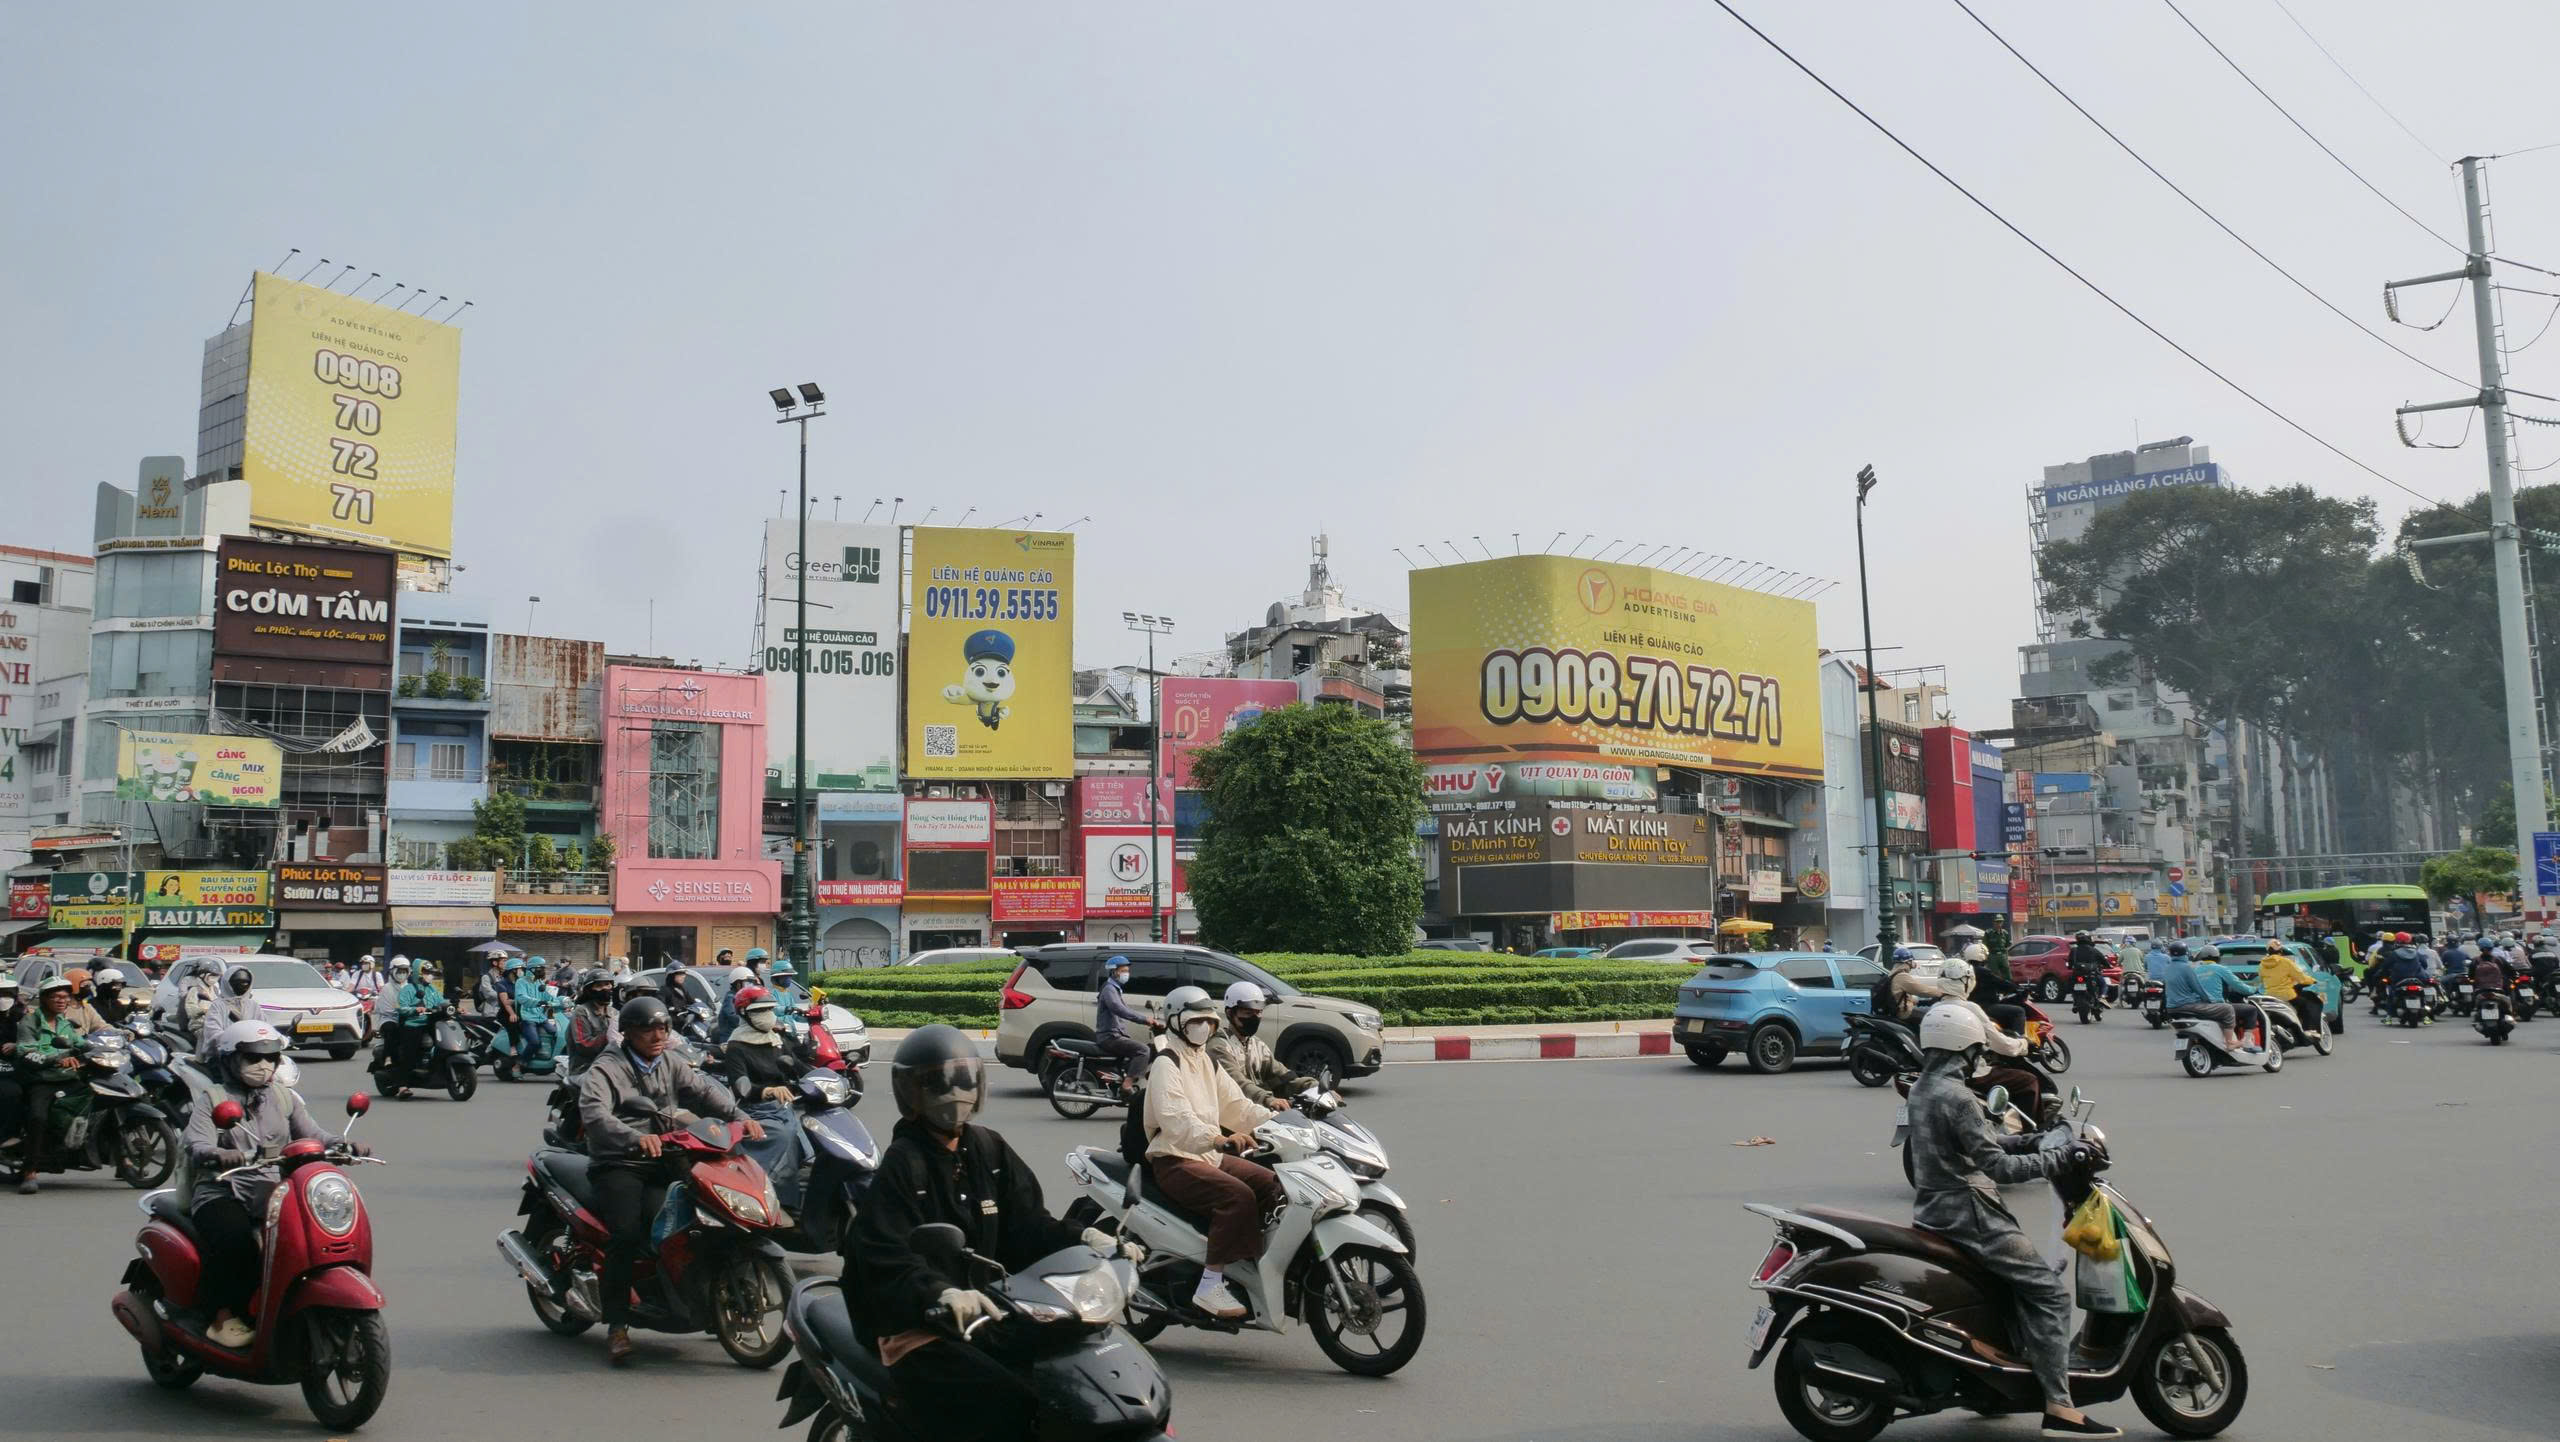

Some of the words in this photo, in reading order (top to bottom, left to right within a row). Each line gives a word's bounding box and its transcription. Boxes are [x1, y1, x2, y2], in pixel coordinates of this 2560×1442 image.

[312, 331, 332, 343] LIÊN
[330, 317, 402, 341] ADVERTISING
[314, 349, 401, 400] 0908
[333, 393, 381, 436] 70
[330, 437, 379, 480] 72
[2057, 485, 2099, 502] NGÂN
[2102, 479, 2146, 497] HÀNG
[2149, 477, 2160, 489] Á
[2162, 469, 2206, 486] CHÂU
[330, 483, 374, 525] 71
[227, 557, 262, 573] Phúc
[266, 561, 290, 578] Lộc
[293, 563, 318, 581] Thọ
[932, 566, 960, 581] LIÊN
[964, 567, 980, 585] HỆ
[984, 568, 1025, 583] QUẢNG
[1029, 569, 1053, 583] CÁO
[226, 588, 309, 617] CƠM
[316, 589, 389, 623] TẤM
[925, 586, 1059, 621] 0911.39.5555
[1624, 602, 1697, 623] ADVERTISING
[809, 631, 822, 643] HỆ
[823, 631, 854, 643] QUẢNG
[855, 633, 874, 644] CÁO
[1603, 630, 1627, 644] LIÊN
[1630, 633, 1644, 648] HỆ
[1647, 636, 1682, 652] QUẢNG
[1683, 642, 1704, 656] CÁO
[1480, 647, 1783, 746] 0908.70.72.71
[622, 703, 658, 714] GELATO
[711, 710, 730, 719] EGG
[730, 711, 753, 720] TART
[216, 748, 246, 760] CÀNG
[1610, 747, 1704, 765] WWW.HOANGGIAADV.COM
[210, 768, 240, 782] CÀNG
[241, 763, 265, 773] MIX
[1520, 766, 1542, 780] VỊT
[1546, 767, 1580, 779] QUAY
[1602, 766, 1632, 782] GIÒN
[1422, 769, 1478, 793] NHƯ
[1484, 765, 1503, 790] Ý
[232, 785, 264, 796] NGON
[1447, 813, 1489, 838] MẮT
[1494, 813, 1541, 835] KÍNH
[1586, 811, 1624, 834] MẮT
[1629, 815, 1668, 837] KÍNH
[1452, 840, 1470, 851] Dr.
[1472, 838, 1507, 850] Minh
[1511, 836, 1536, 850] Tây
[1608, 837, 1627, 851] Dr.
[1628, 838, 1660, 852] Minh
[1663, 838, 1686, 854] Tây
[1487, 853, 1504, 862] GIA
[281, 867, 313, 881] Phúc
[314, 869, 336, 883] Lộc
[338, 868, 362, 883] Thọ
[674, 881, 720, 894] SENSE
[725, 881, 753, 894] TEA
[819, 884, 831, 895] CHO
[832, 882, 848, 895] THUÊ
[201, 893, 256, 904] 14.000
[86, 917, 123, 926] 14.000
[148, 910, 192, 925] RAU
[195, 907, 227, 925] MÁ
[227, 911, 264, 925] mix
